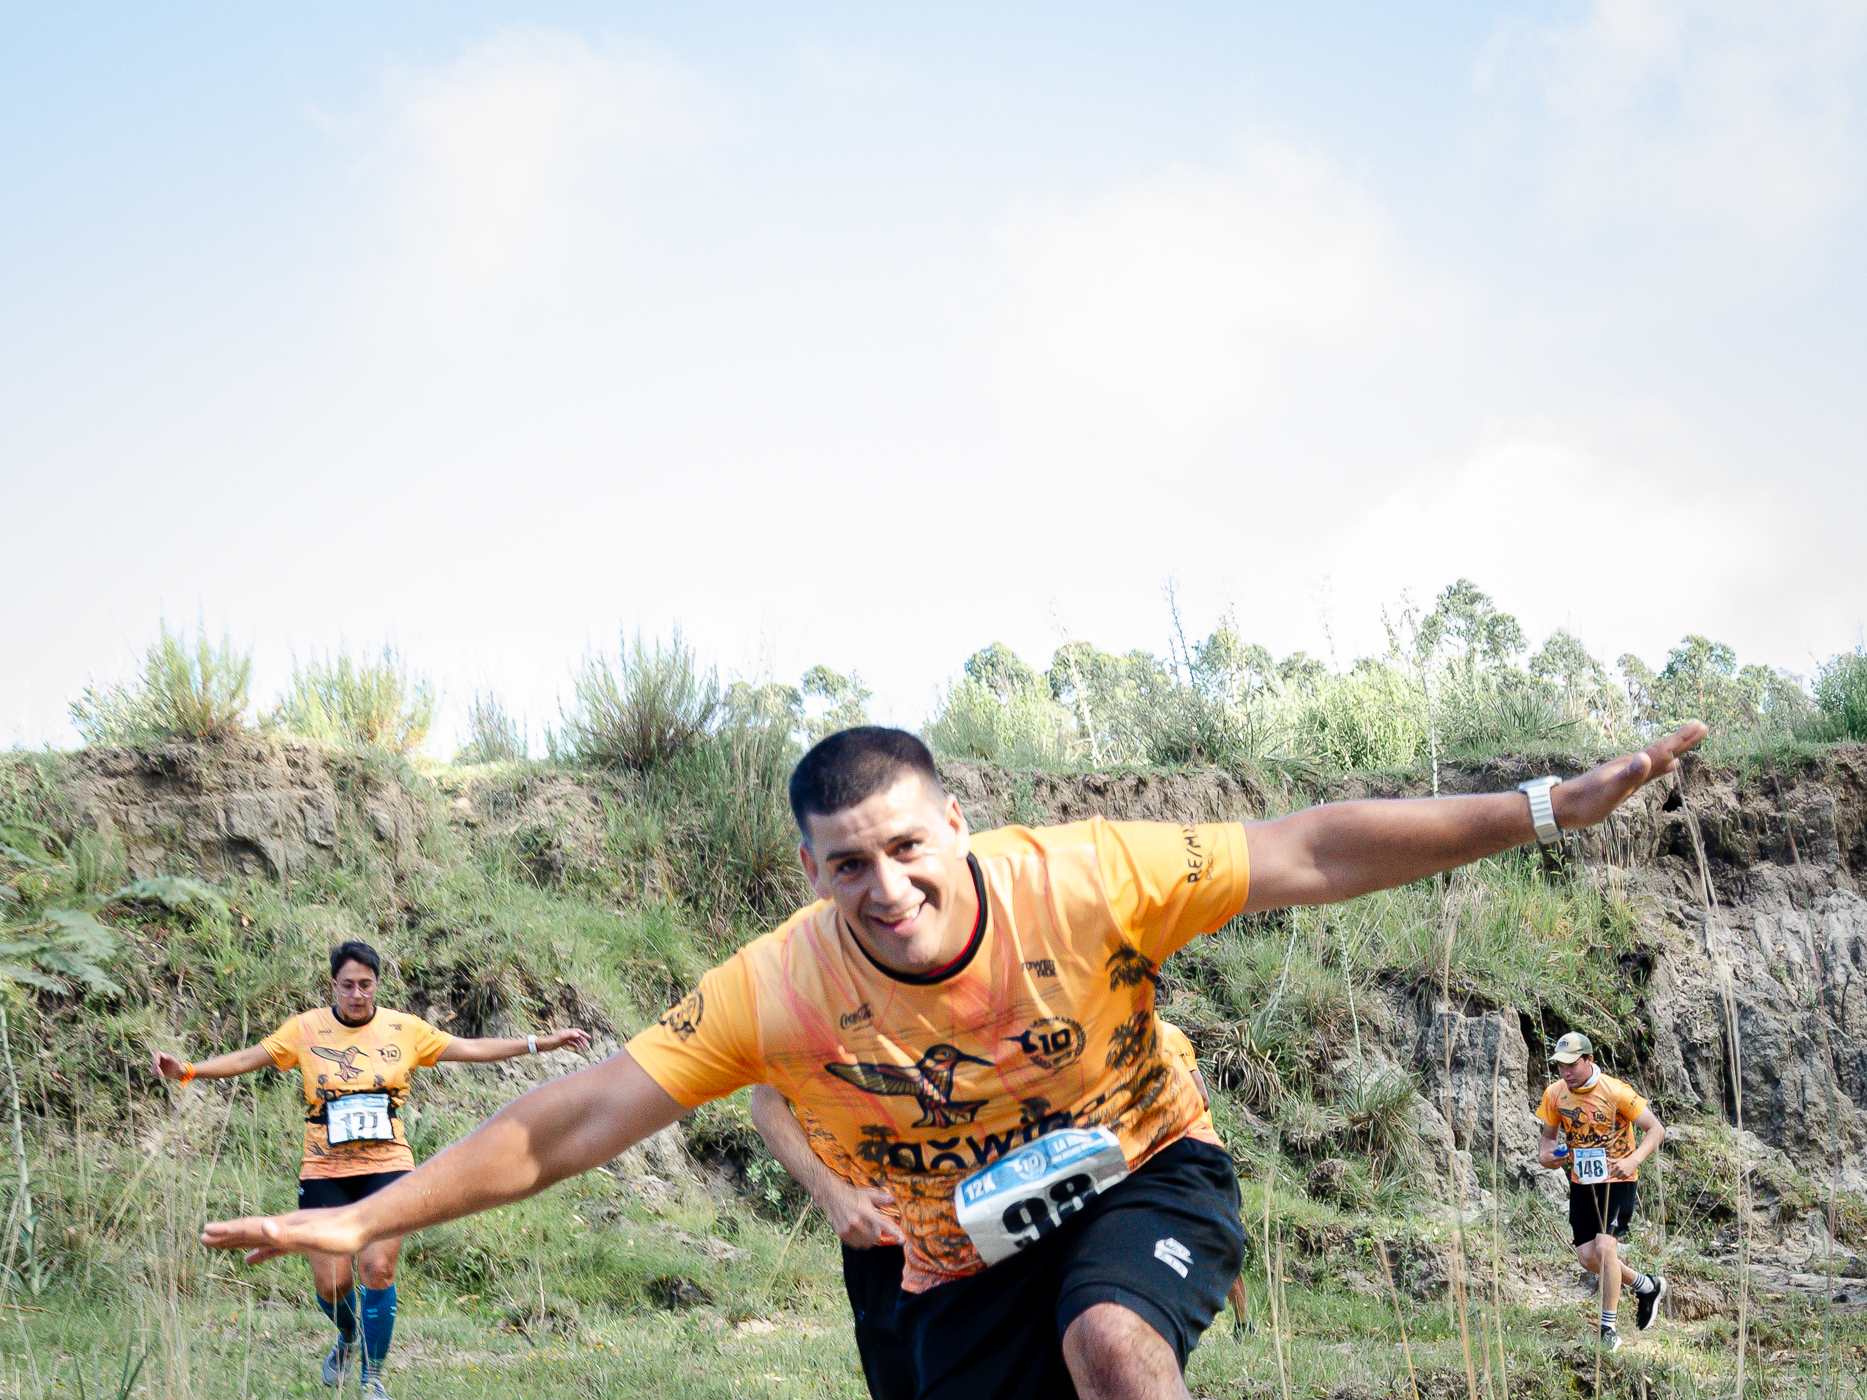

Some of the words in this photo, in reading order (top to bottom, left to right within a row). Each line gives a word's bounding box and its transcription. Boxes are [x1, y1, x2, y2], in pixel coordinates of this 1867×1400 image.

[1038, 1028, 1072, 1057] 10
[1576, 1159, 1604, 1178] 148
[964, 1172, 997, 1201] 12K
